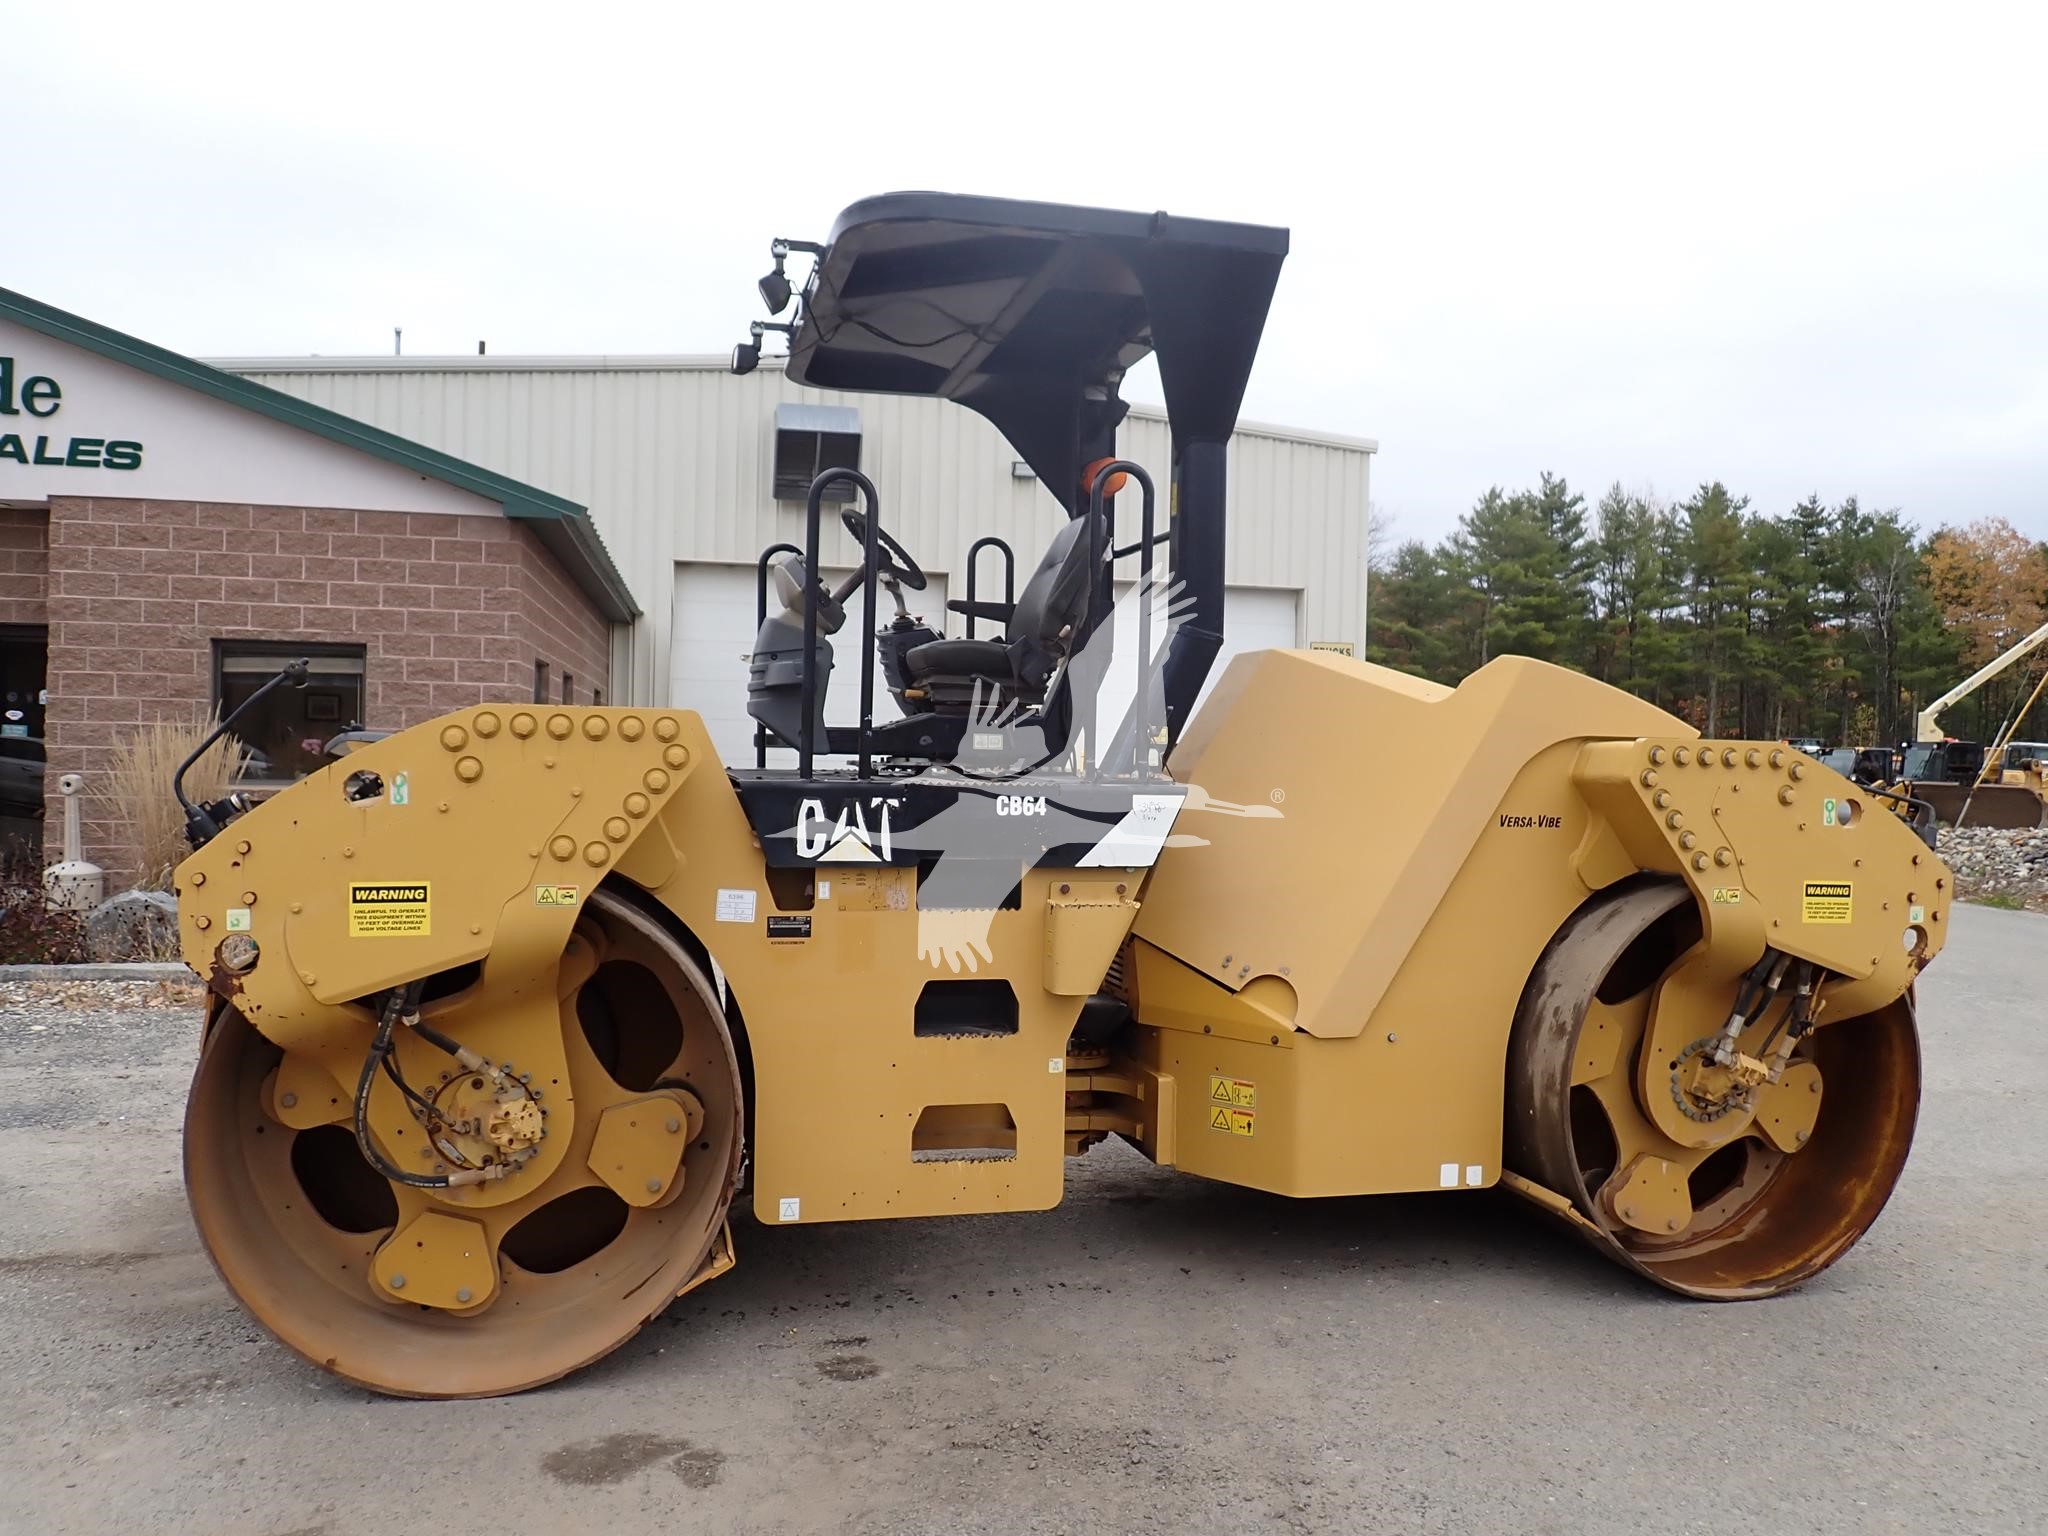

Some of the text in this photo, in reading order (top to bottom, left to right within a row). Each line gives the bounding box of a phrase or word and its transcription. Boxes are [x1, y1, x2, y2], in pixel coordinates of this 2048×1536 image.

[996, 795, 1047, 816] CB64
[797, 797, 900, 862] CAT
[355, 889, 425, 900] WARNING
[1807, 886, 1849, 895] WARNING
